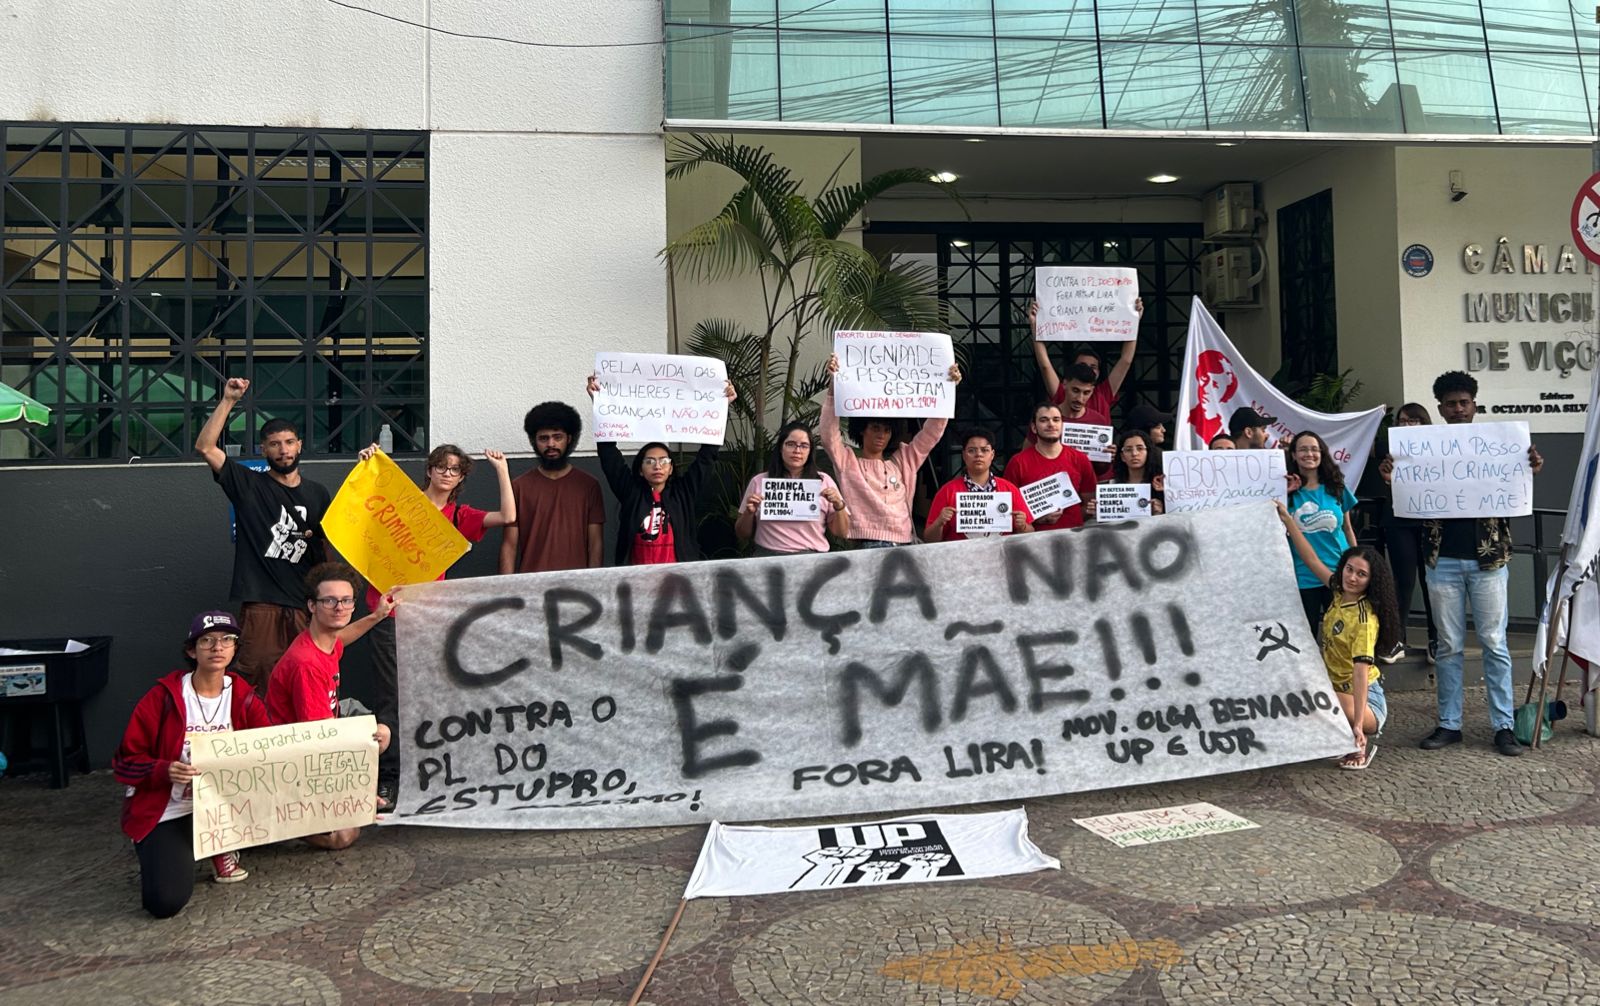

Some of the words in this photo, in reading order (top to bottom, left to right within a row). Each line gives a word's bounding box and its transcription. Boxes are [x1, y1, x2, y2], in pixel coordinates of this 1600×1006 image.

[1045, 275, 1079, 288] CONTRA
[846, 344, 943, 368] DIGNIDADE
[1466, 341, 1510, 371] DE
[600, 360, 642, 375] PELA
[651, 363, 685, 378] VIDA
[694, 366, 717, 378] DAS
[856, 367, 930, 382] PESSOAS
[600, 381, 670, 399] MULHERES
[675, 388, 685, 400] E
[694, 390, 715, 402] DAS
[883, 381, 946, 399] GESTAM
[598, 404, 666, 420] CRIANÇAS!
[671, 407, 698, 418] NÃO
[702, 409, 720, 419] AO
[844, 396, 889, 411] CONTRA
[1492, 404, 1542, 414] OCTAVIO
[1544, 404, 1562, 413] DA
[1563, 403, 1589, 413] SILV
[665, 424, 676, 433] PL
[1334, 448, 1351, 463] de
[1399, 439, 1434, 456] NEM
[1441, 439, 1462, 456] UM
[1468, 436, 1521, 457] PASSO
[1167, 455, 1262, 490] ABORTO
[1268, 451, 1282, 481] É
[1394, 459, 1445, 483] ATRÁS!
[1452, 460, 1525, 482] CRIANÇA
[764, 490, 783, 500] NÃO
[785, 490, 791, 500] É
[793, 490, 815, 501] MÃE!
[765, 481, 805, 492] CRIANÇA
[1408, 489, 1449, 513] NÃO
[1456, 489, 1466, 510] É
[1479, 484, 1528, 510] MÃE!
[959, 509, 986, 517] CRIANÇA
[445, 548, 938, 689] CRIANÇA
[1004, 519, 1196, 602] NÃO
[672, 643, 763, 779] É
[840, 604, 1202, 748] MÃE!!!
[414, 700, 574, 750] CONTRA
[591, 695, 617, 722] O
[1062, 709, 1128, 741] MOV.
[1137, 697, 1201, 732] OLGA
[1208, 690, 1341, 725] BENARIO,
[211, 737, 249, 758] Pela
[253, 726, 312, 763] garantia
[316, 725, 338, 740] do
[1105, 740, 1154, 765] UP
[1198, 725, 1267, 757] UJR
[303, 750, 370, 777] LEGAL
[417, 753, 467, 792] PL
[495, 743, 548, 776] DO
[792, 756, 922, 791] FORA
[943, 737, 1047, 780] LIRA!
[303, 773, 371, 797] SEGURO
[411, 768, 638, 814] ESTUPRO,
[205, 799, 255, 828] NEM
[275, 800, 316, 824] NEM
[320, 794, 374, 820] MORTAS
[1083, 814, 1131, 828] PELA
[1136, 809, 1181, 822] VIDA
[198, 824, 270, 852] PRESAS
[834, 822, 928, 849] UP
